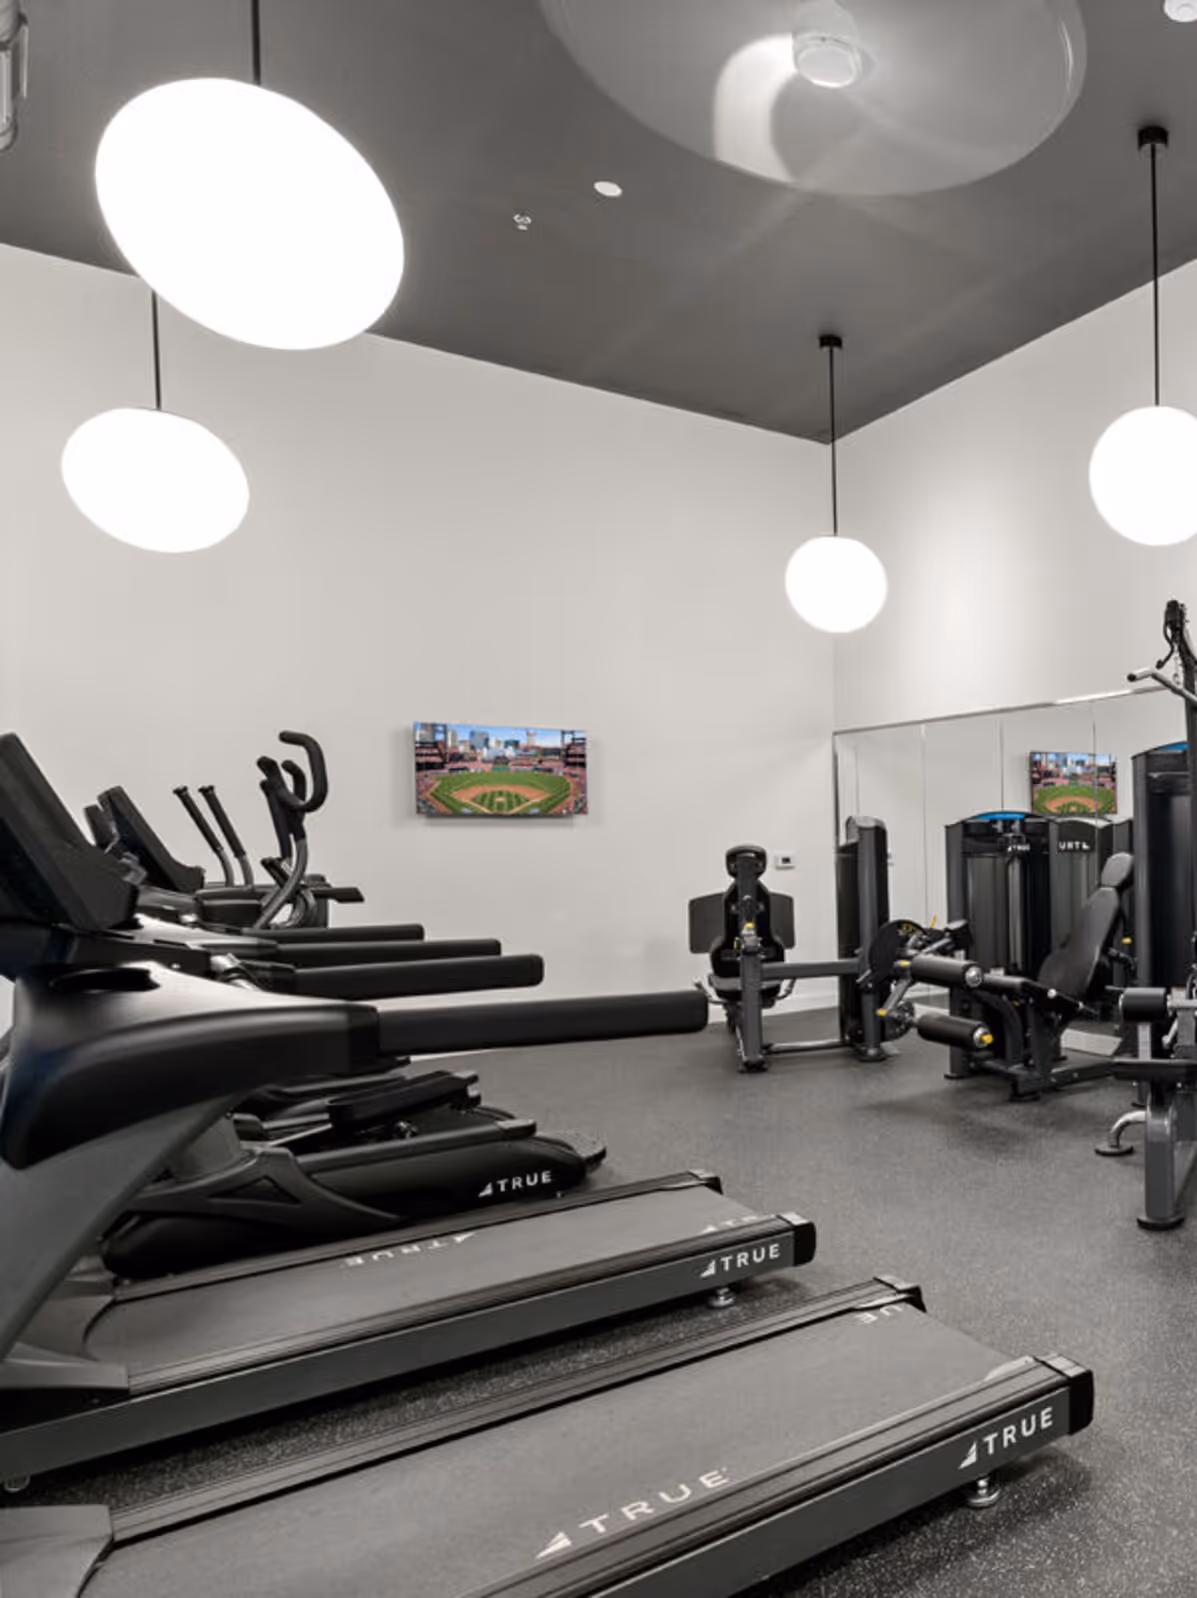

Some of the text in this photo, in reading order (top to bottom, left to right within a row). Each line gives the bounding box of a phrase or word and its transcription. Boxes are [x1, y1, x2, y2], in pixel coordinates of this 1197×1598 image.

[496, 1170, 551, 1193] TRUE
[720, 1243, 780, 1272] TRUE
[983, 1406, 1053, 1455] TRUE
[578, 1469, 729, 1534] TRUE
